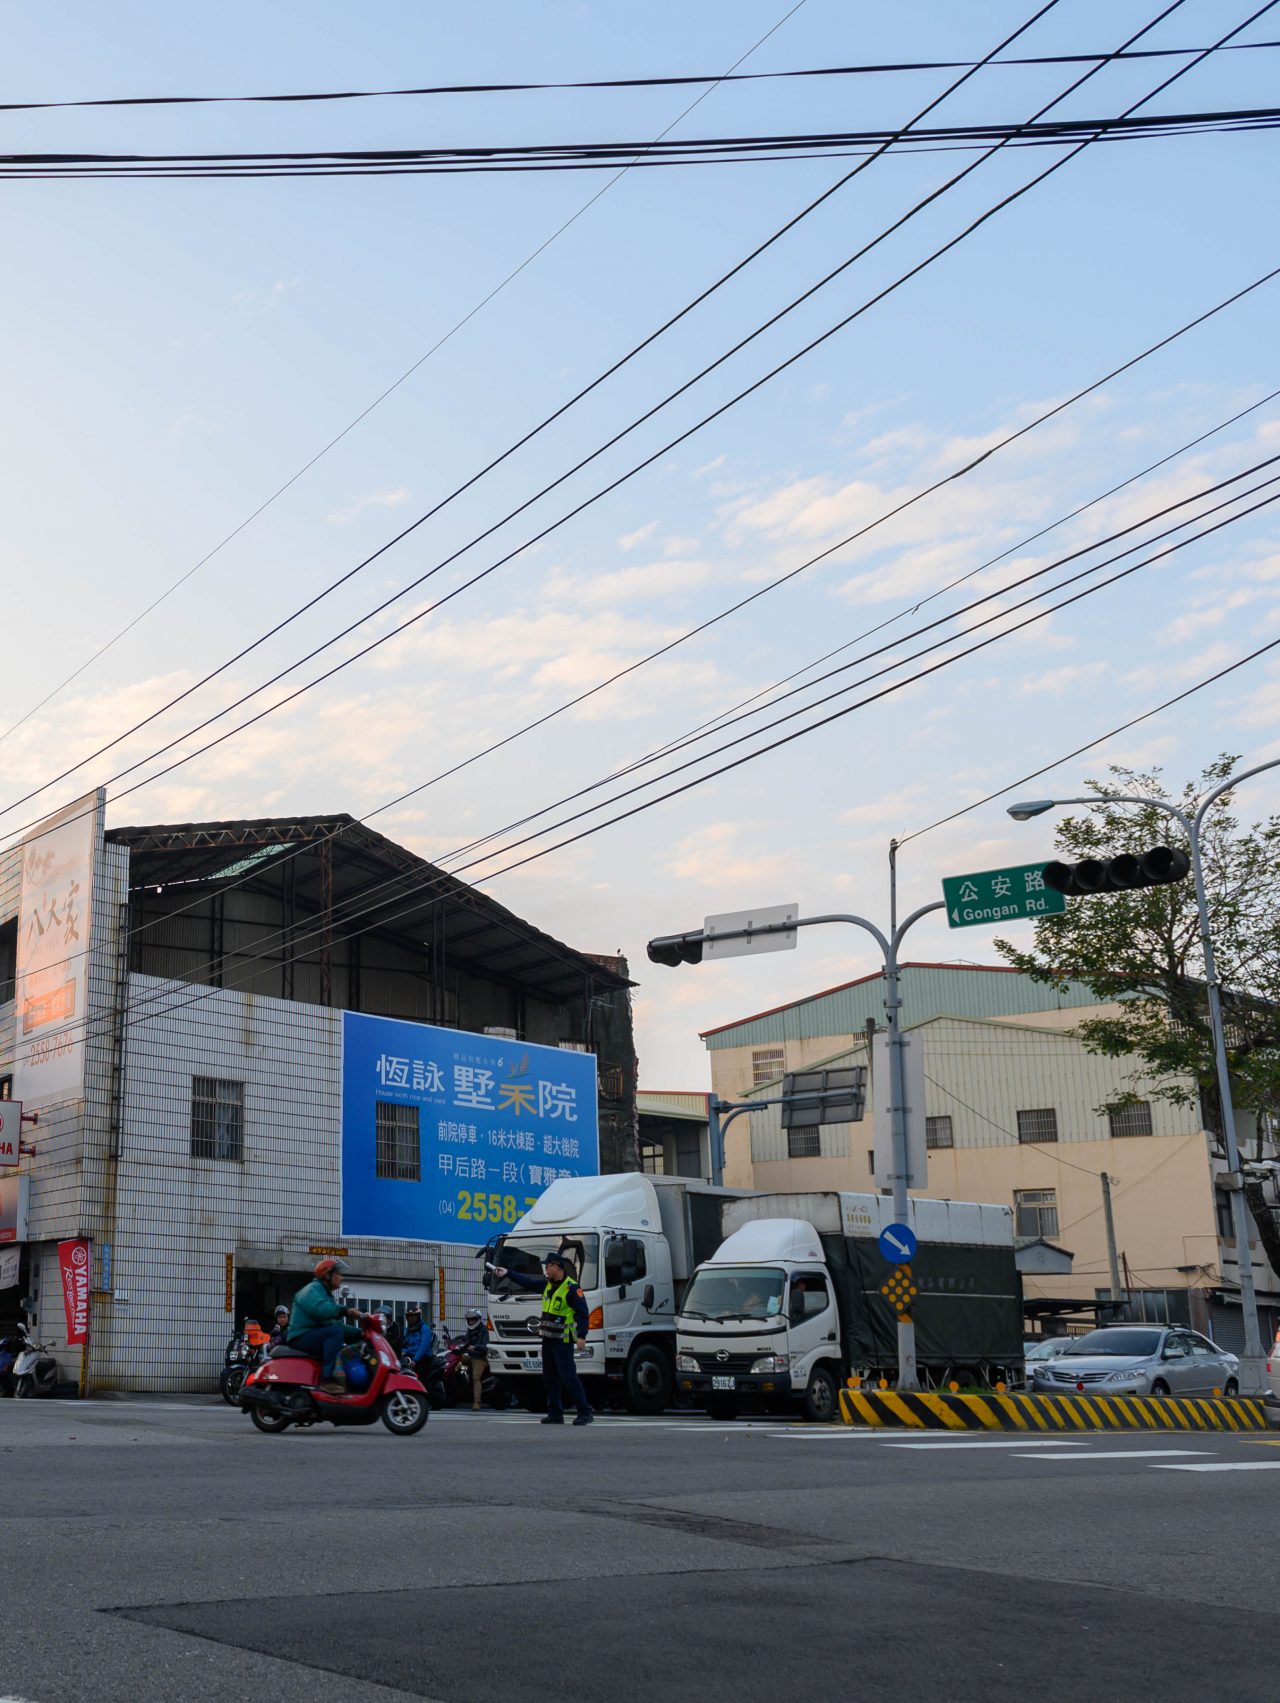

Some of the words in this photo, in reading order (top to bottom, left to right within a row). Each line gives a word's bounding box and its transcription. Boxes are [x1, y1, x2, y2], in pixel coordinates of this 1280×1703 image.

[959, 870, 1046, 903] 公安路
[963, 903, 1018, 920] Gongan
[1025, 898, 1049, 912] Rd.
[375, 1053, 446, 1093] 恆詠
[375, 1088, 393, 1097] House
[395, 1091, 408, 1099] with
[438, 1120, 477, 1144] 前院停車
[487, 1130, 535, 1151] 16米大棟距
[543, 1135, 579, 1158] 超大後院
[438, 1200, 455, 1216] (04)
[74, 1266, 87, 1335] YAMAHA
